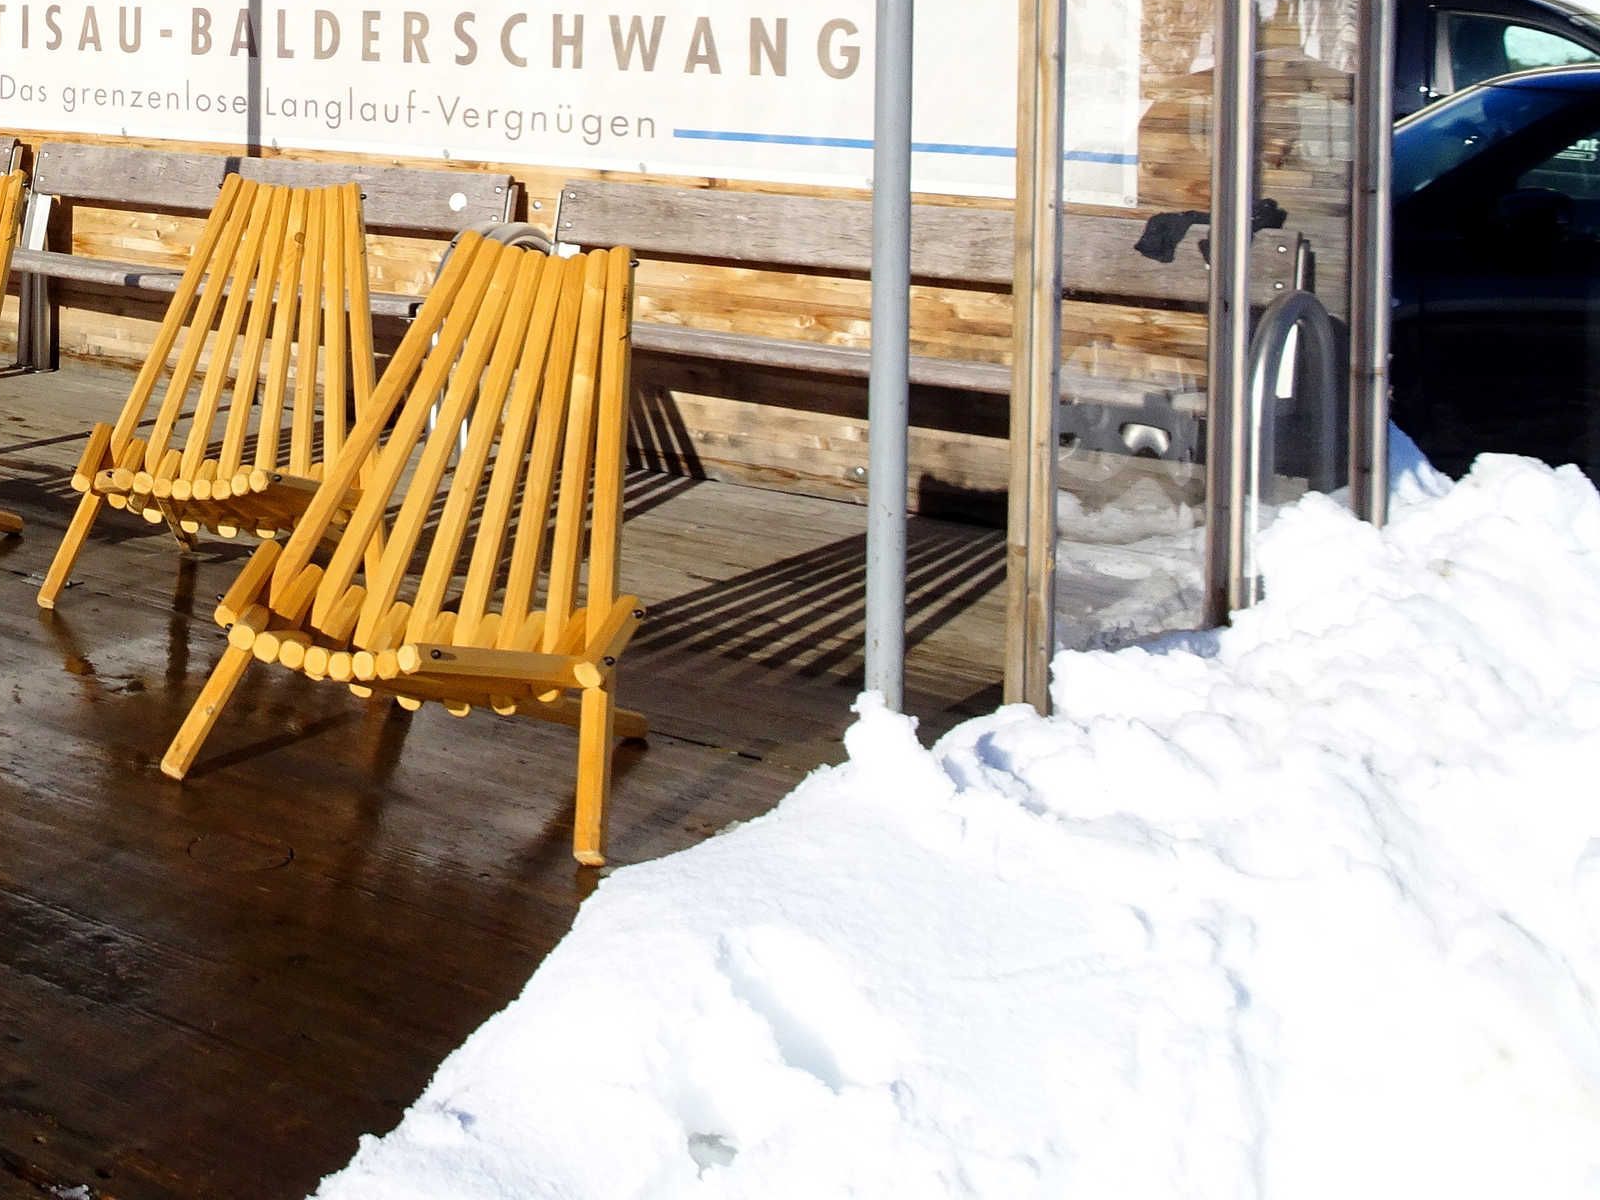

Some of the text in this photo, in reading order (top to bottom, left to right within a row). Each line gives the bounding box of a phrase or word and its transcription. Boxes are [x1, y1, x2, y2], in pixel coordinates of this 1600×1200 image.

[0, 74, 656, 145] Das grenzenlose Langlauf-Vergnügen
